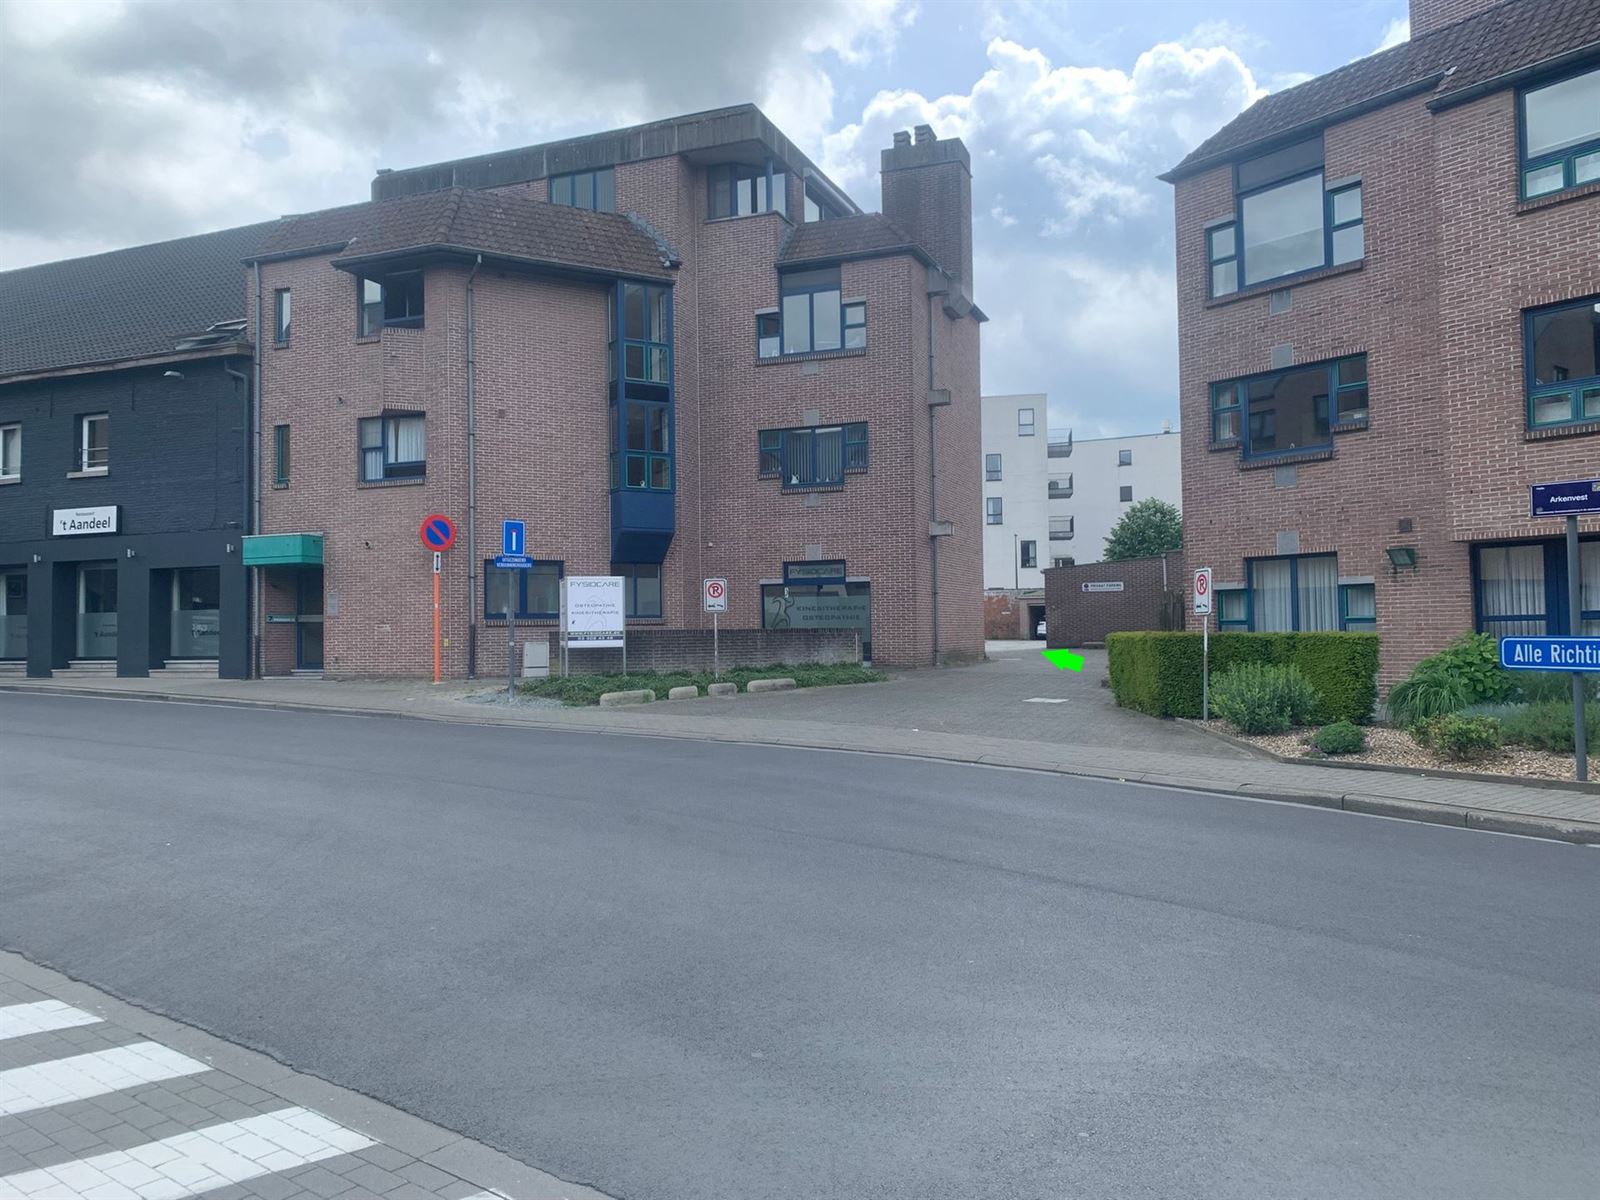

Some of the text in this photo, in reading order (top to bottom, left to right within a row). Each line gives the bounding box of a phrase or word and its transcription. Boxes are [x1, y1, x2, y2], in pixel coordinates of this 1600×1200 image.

[1550, 494, 1588, 503] Arkenvest
[69, 516, 111, 530] Aandeel
[1514, 643, 1600, 664] Alle Richti
